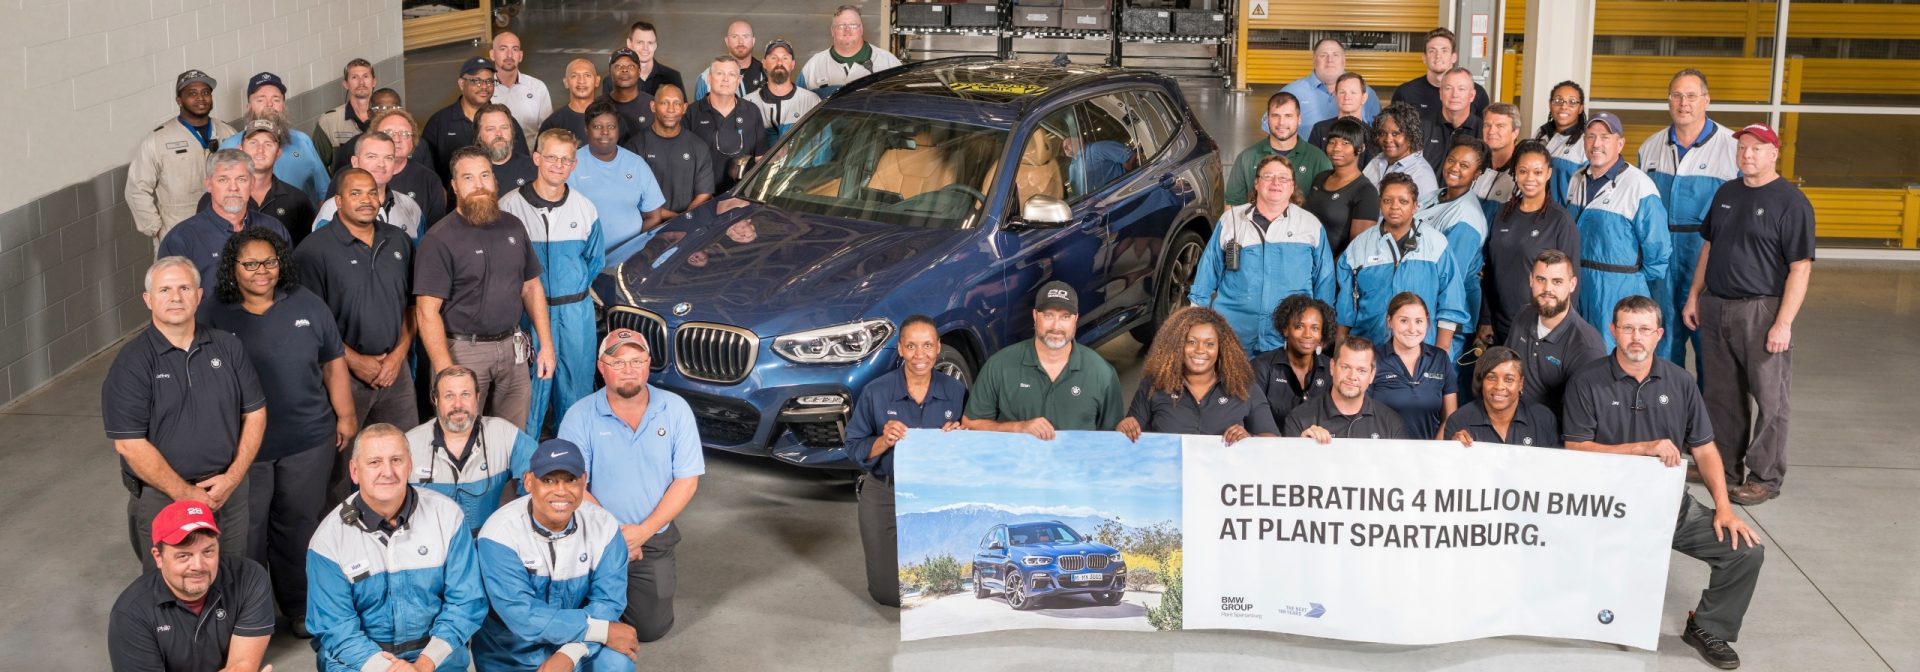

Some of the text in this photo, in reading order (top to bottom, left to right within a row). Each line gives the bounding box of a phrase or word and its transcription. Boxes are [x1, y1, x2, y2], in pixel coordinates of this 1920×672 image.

[1220, 483, 1627, 519] CELEBRATING 4 MILLION BMWs
[1219, 518, 1546, 549] AT PLANT SPARTANBURG.
[1221, 596, 1244, 604] BMW
[1221, 603, 1253, 611] GROUP
